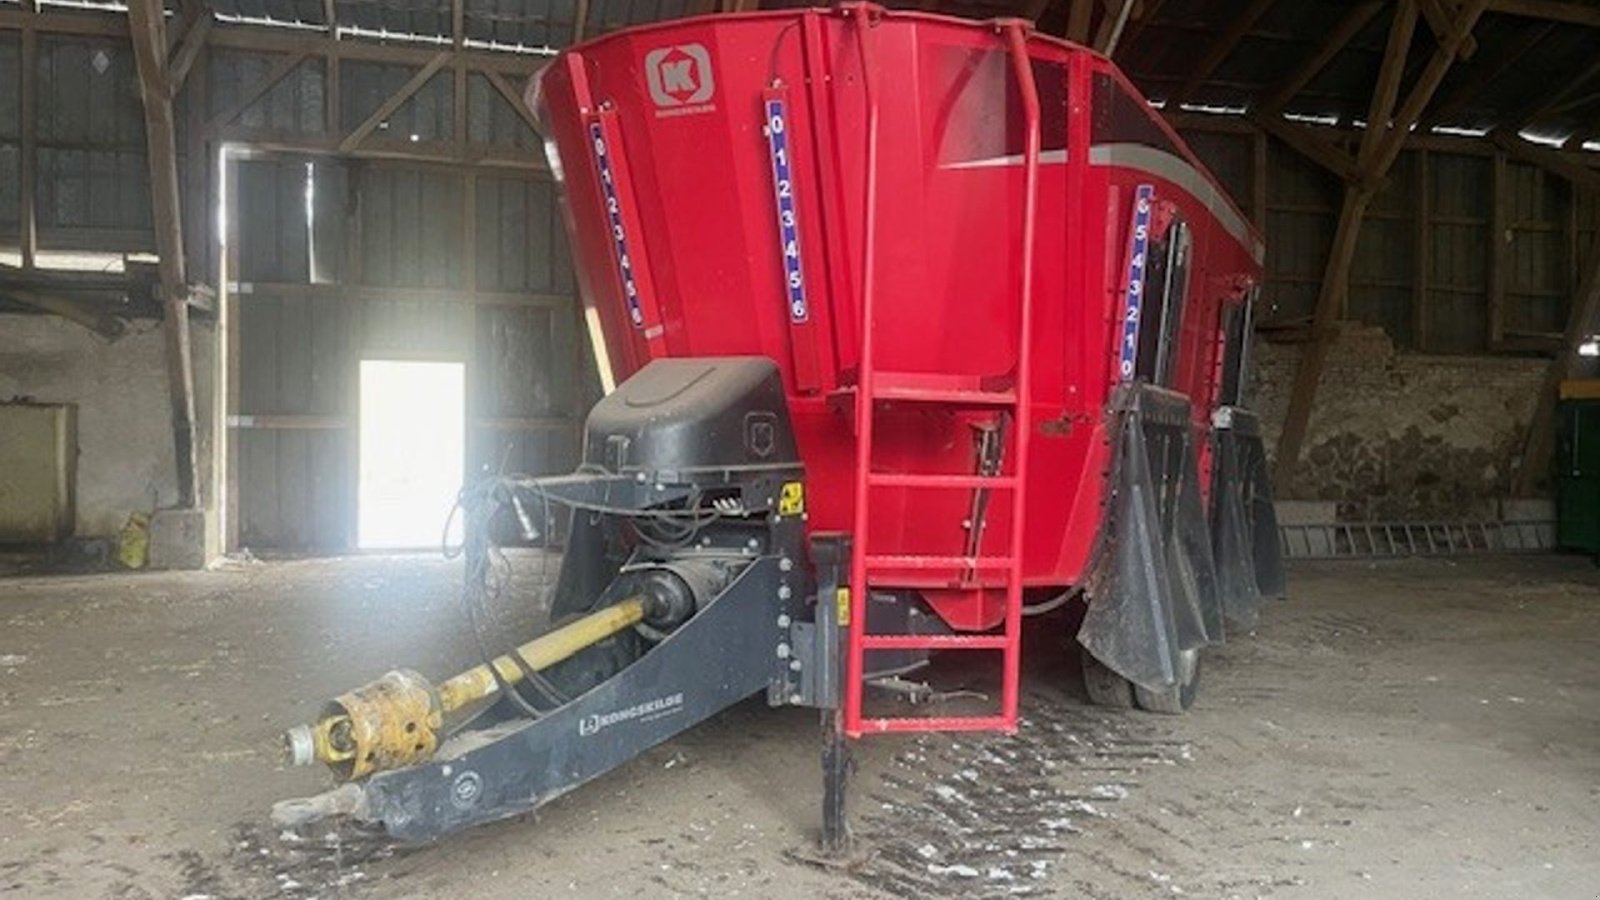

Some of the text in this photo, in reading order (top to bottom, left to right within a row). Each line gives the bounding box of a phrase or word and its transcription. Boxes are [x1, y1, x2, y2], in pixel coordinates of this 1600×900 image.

[662, 59, 696, 92] K
[608, 197, 618, 213] 2
[614, 225, 624, 240] 3
[771, 115, 805, 316] 0 1 2 3 4 5 6
[1135, 225, 1147, 240] 5
[1132, 253, 1144, 267] 4
[1130, 280, 1141, 295] 3
[1127, 306, 1138, 321] 2
[1125, 333, 1134, 347] 1
[1122, 360, 1132, 375] 0
